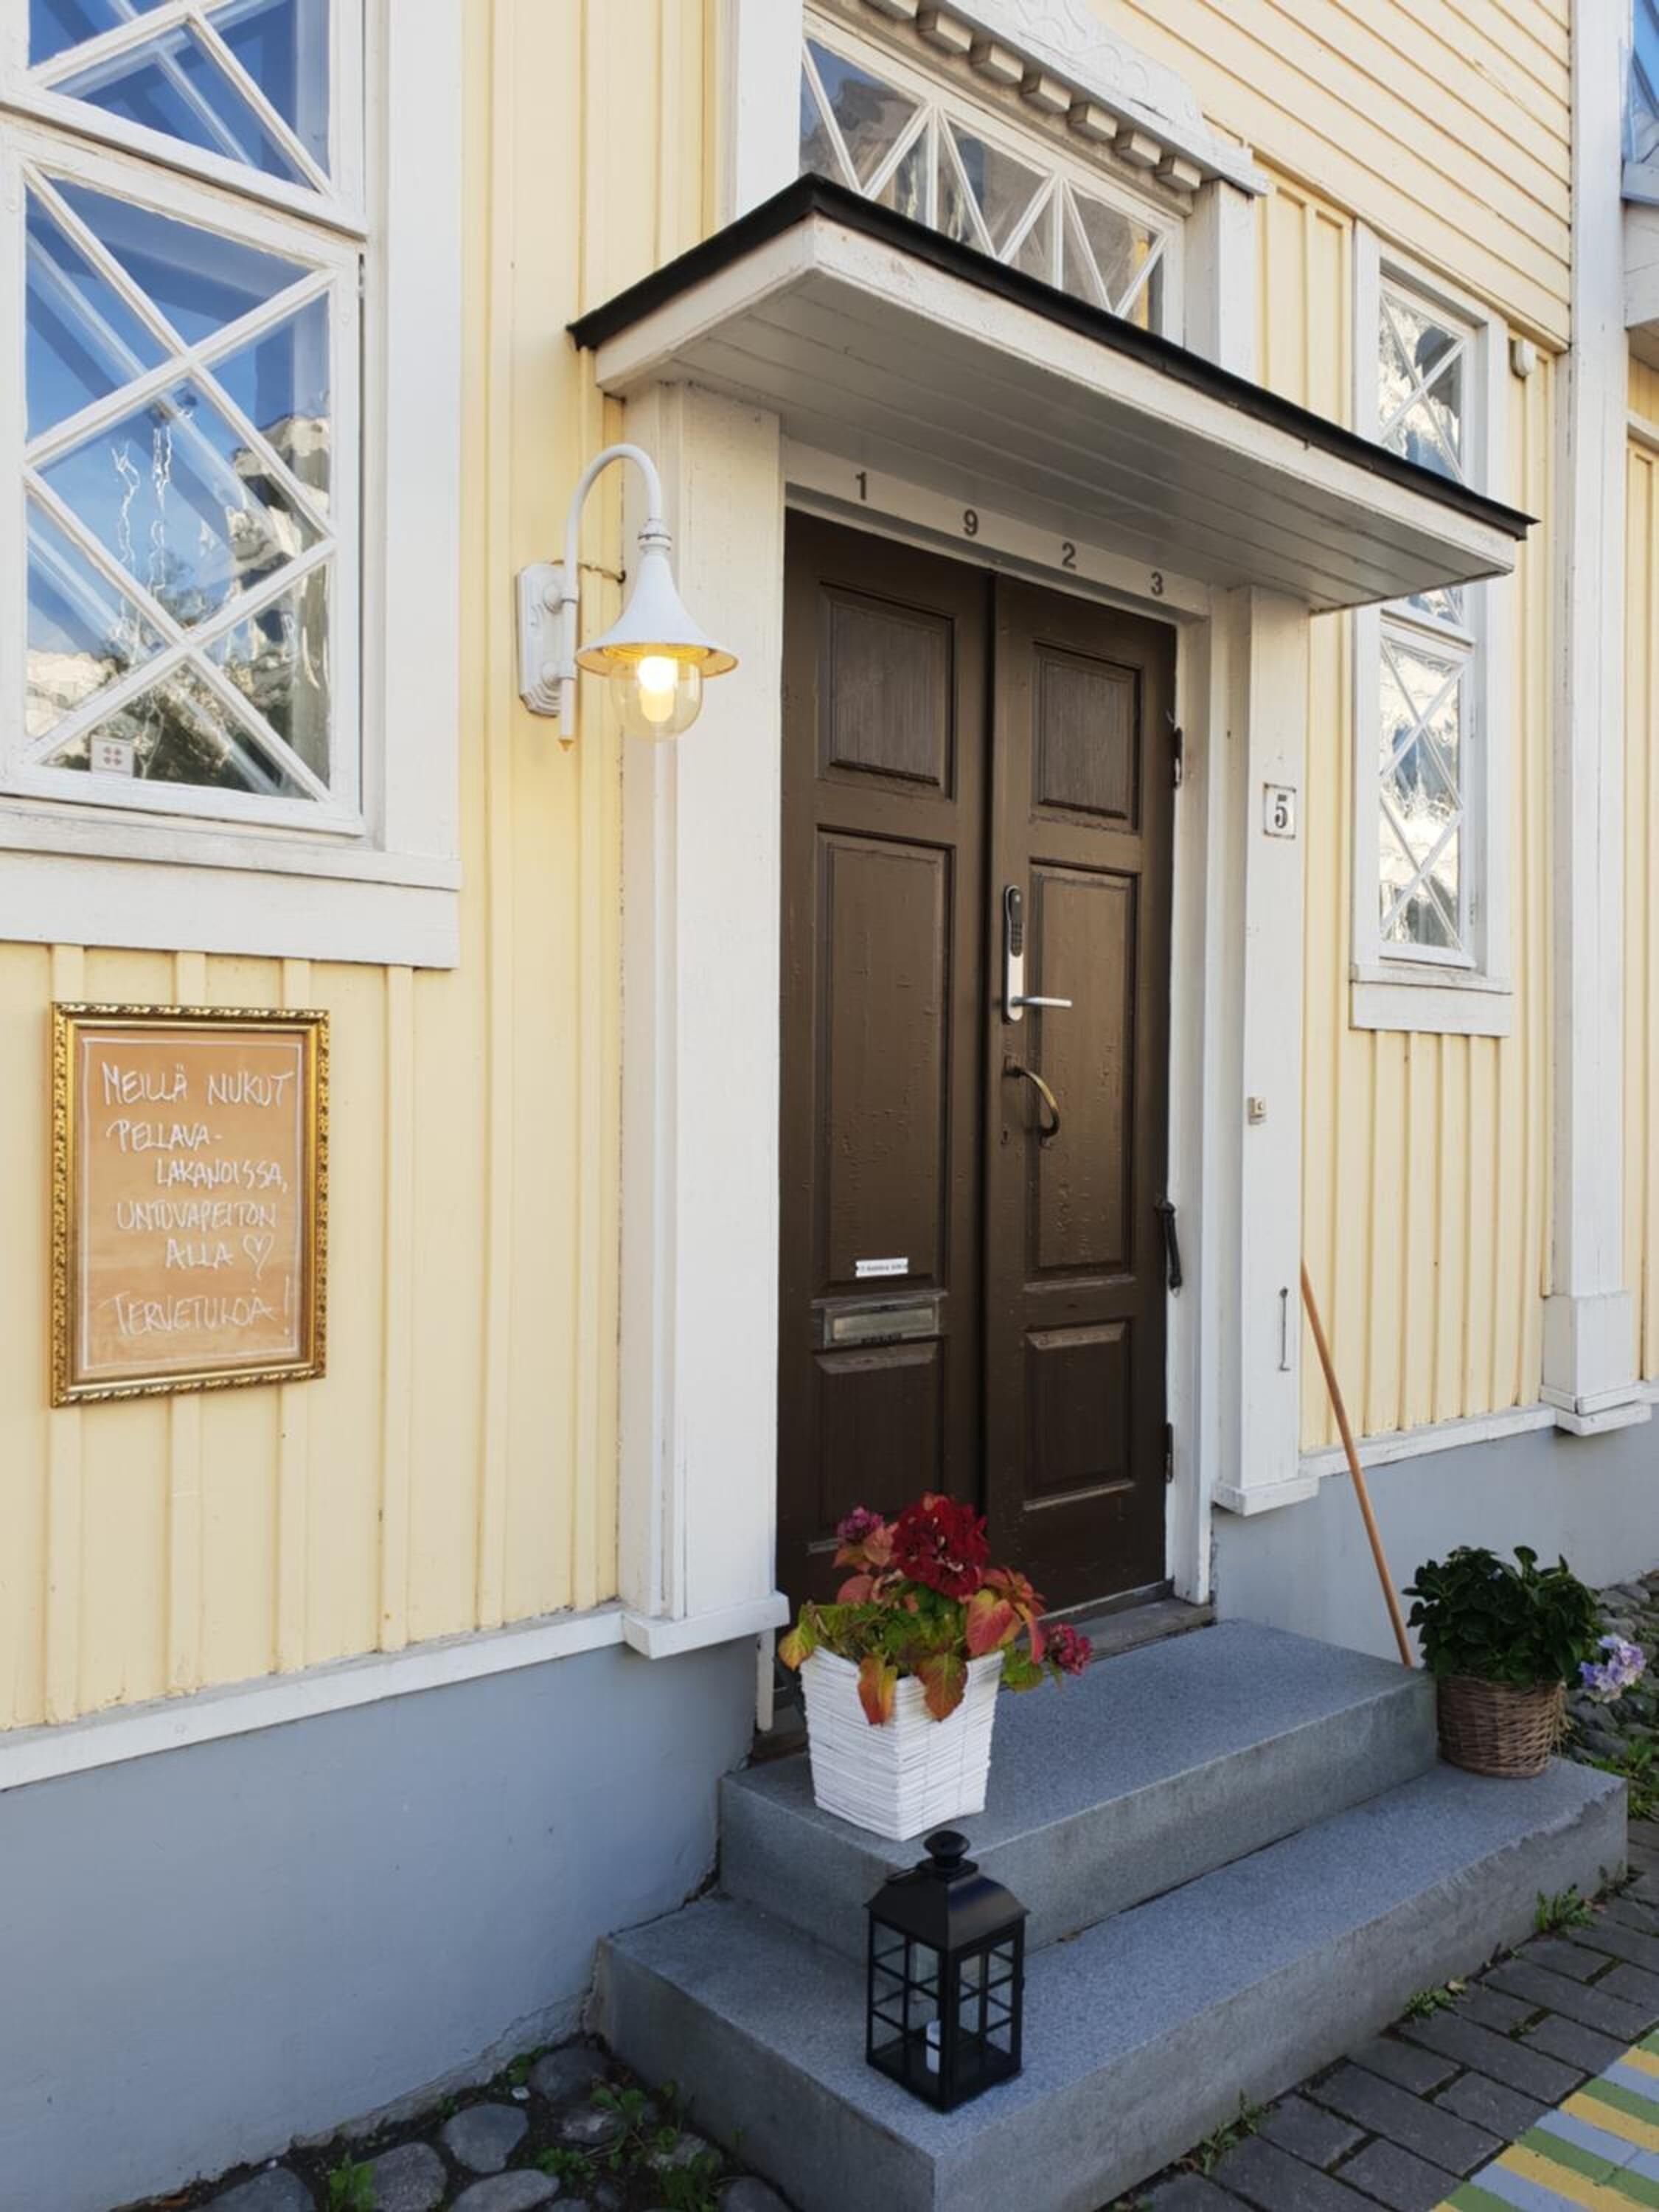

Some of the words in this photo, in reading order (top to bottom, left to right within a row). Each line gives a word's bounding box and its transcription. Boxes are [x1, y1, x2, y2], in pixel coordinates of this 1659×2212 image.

[1275, 794, 1288, 829] 5
[102, 1061, 187, 1105] MEILLÄ
[208, 1070, 294, 1107] NUKUT
[106, 1119, 223, 1152] PELLAVA-
[165, 1239, 234, 1269] ALLA
